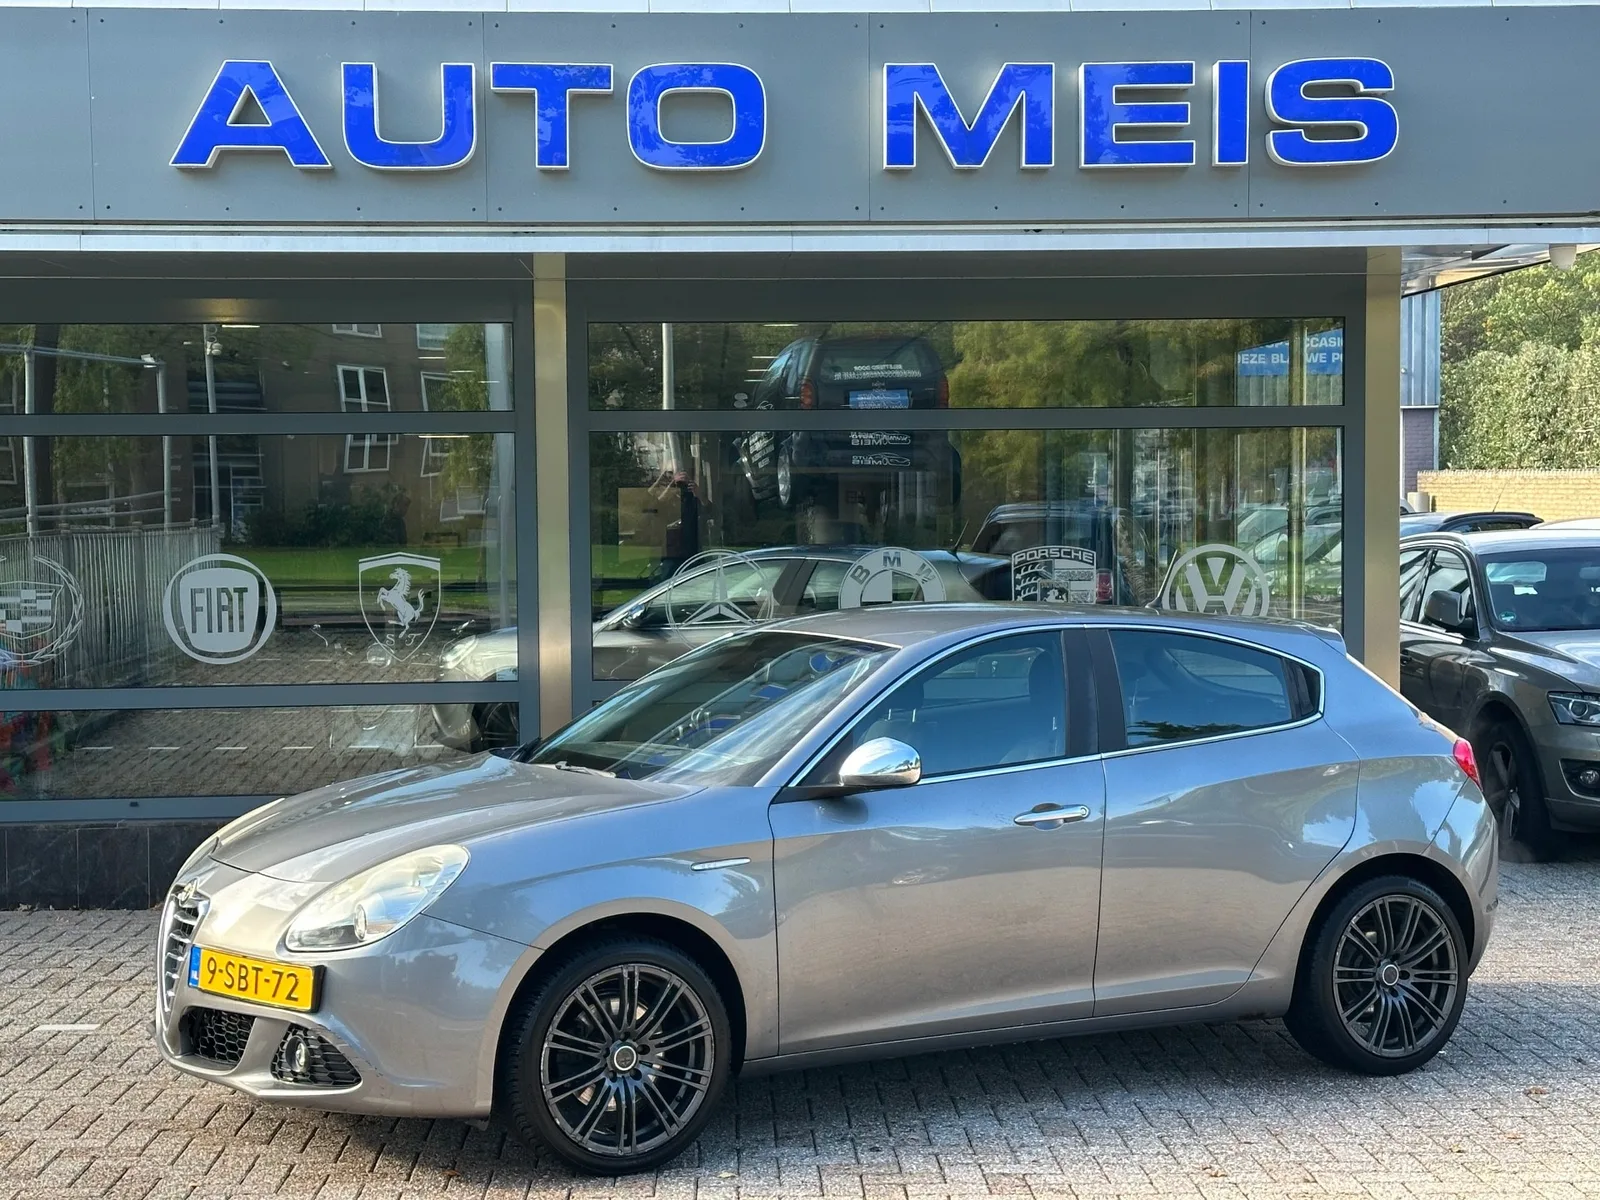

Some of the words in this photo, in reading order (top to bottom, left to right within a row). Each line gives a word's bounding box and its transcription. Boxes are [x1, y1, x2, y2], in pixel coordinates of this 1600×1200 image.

[169, 59, 767, 171] AUTO
[882, 57, 1400, 170] MEIS
[850, 551, 937, 586] BMW
[1014, 548, 1094, 565] PORSCHE
[189, 587, 249, 634] FIAT
[206, 956, 300, 1002] 9-SBT-72
